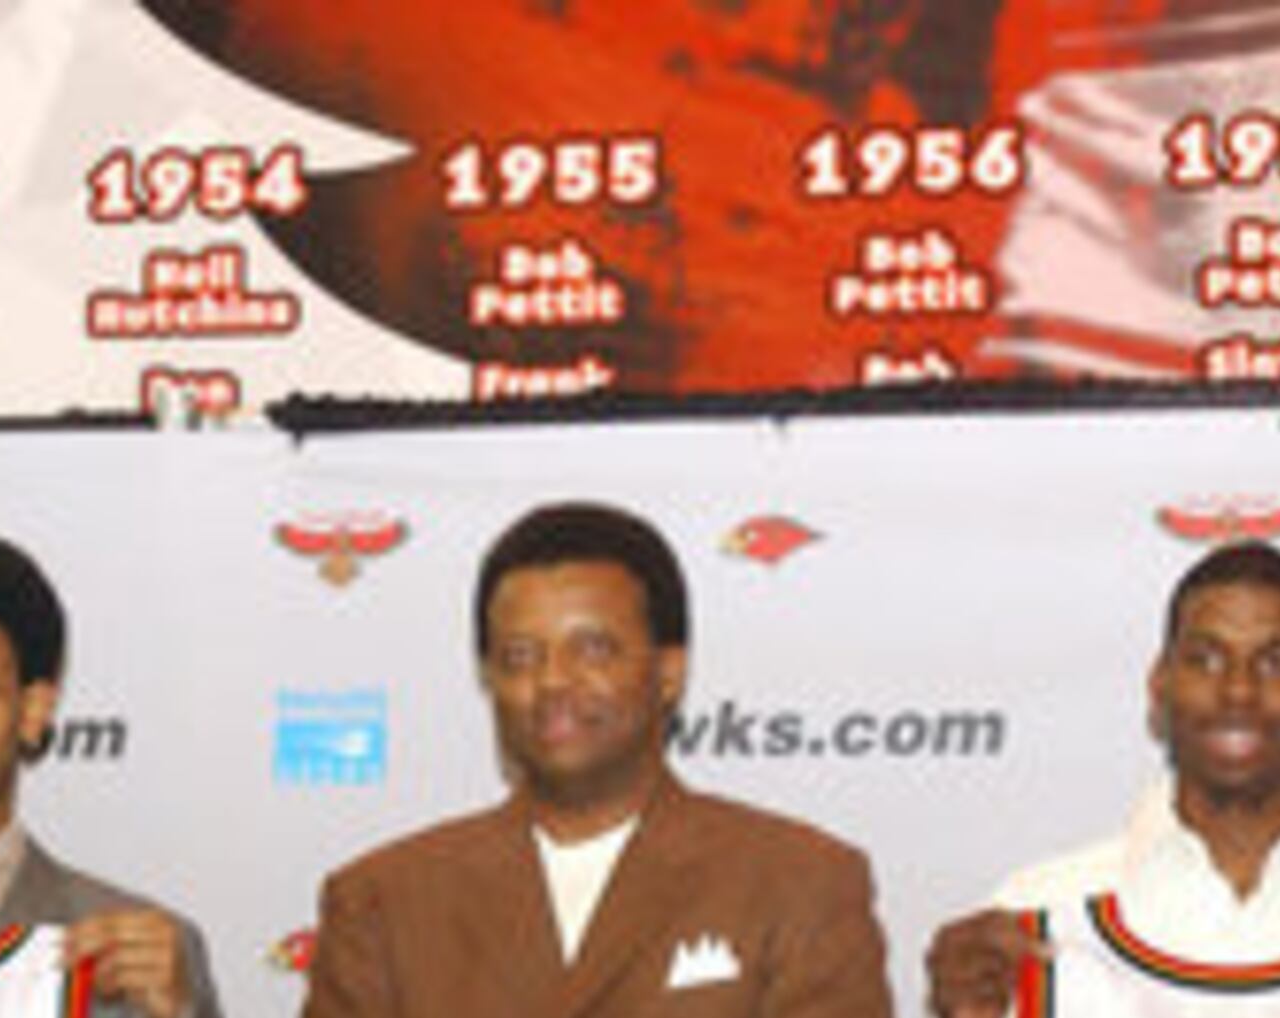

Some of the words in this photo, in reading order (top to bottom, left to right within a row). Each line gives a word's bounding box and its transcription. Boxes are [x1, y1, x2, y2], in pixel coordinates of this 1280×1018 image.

[91, 147, 306, 218] 1954
[441, 137, 659, 208] 1955
[801, 128, 1022, 197] 1956
[500, 239, 593, 283] Bob
[862, 229, 958, 272] Bob
[470, 282, 624, 324] Pettit
[832, 272, 989, 312] Pettit
